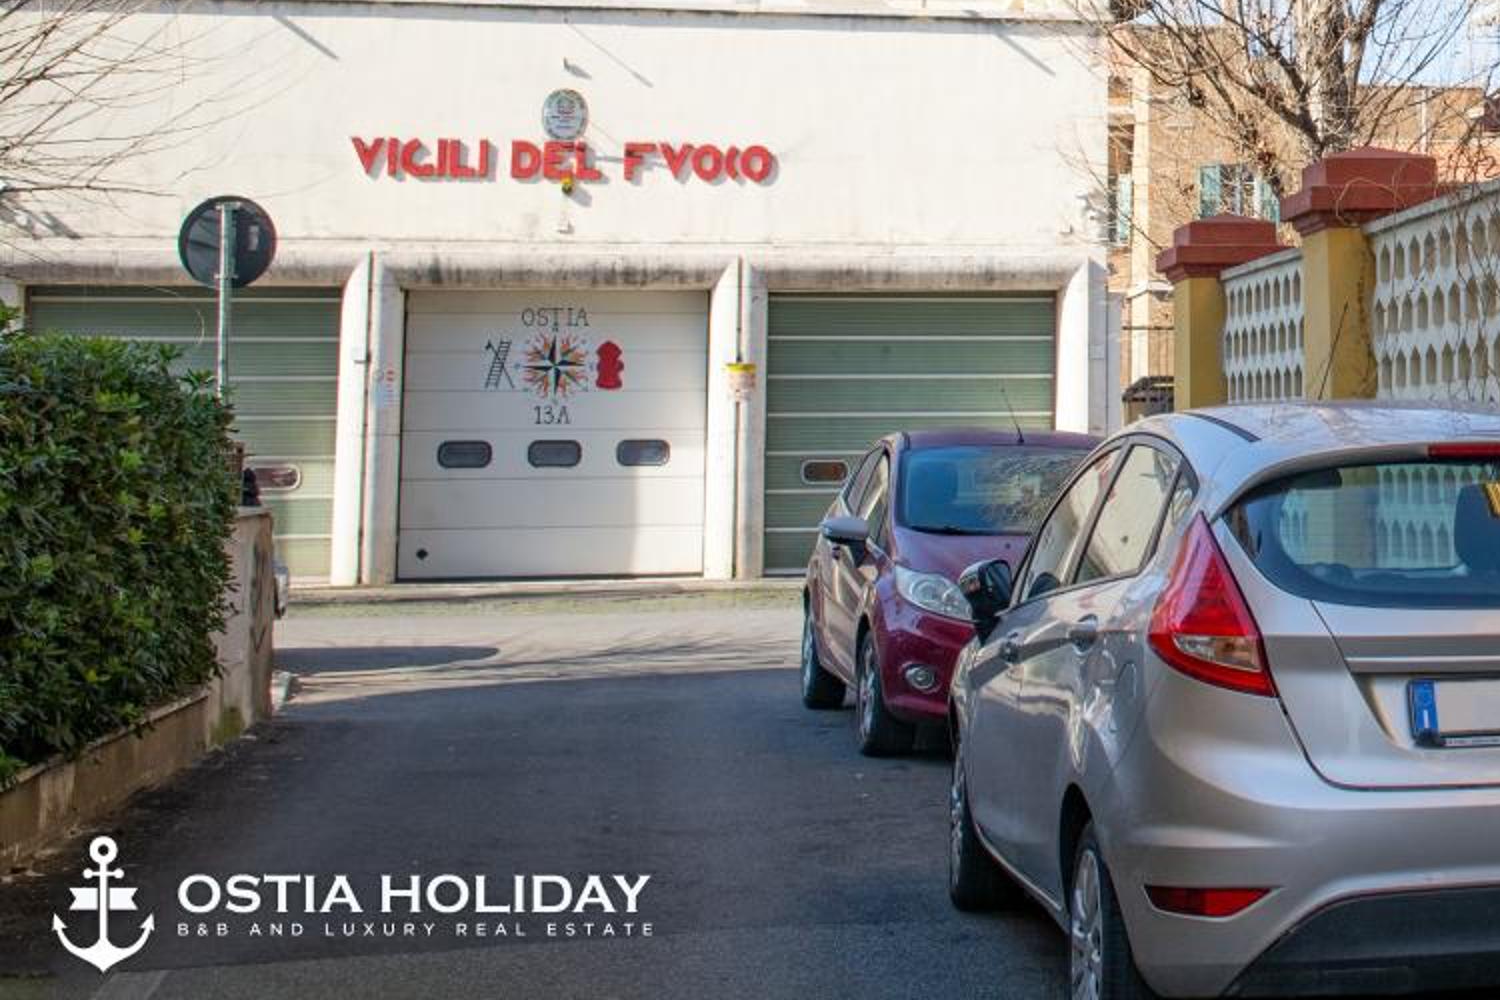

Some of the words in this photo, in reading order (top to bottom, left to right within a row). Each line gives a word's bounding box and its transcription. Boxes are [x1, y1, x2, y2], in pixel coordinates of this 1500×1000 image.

[352, 137, 489, 178] VIGILI
[511, 140, 601, 180] DEL
[521, 307, 590, 327] OSTIA
